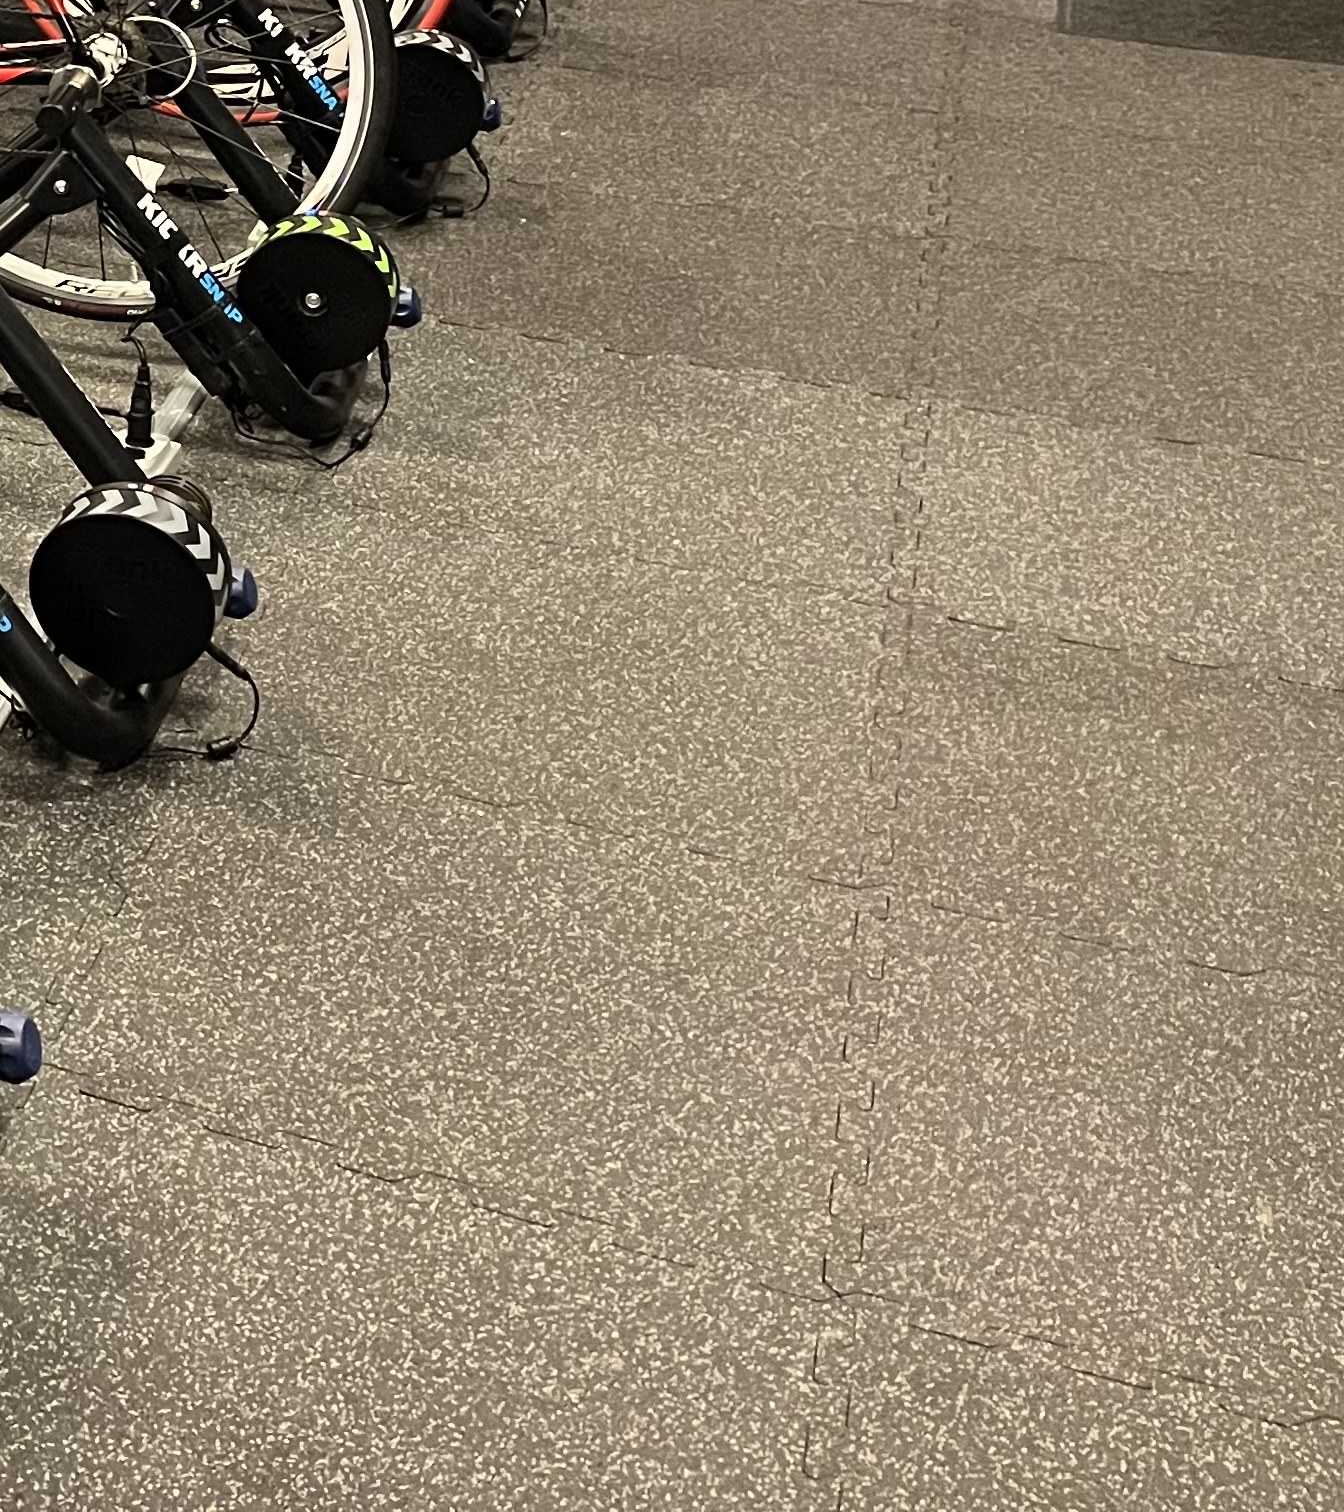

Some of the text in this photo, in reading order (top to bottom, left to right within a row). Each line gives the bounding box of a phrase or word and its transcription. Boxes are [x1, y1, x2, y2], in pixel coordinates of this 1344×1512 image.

[257, 7, 346, 121] KIKR SNA
[198, 271, 245, 325] SNP
